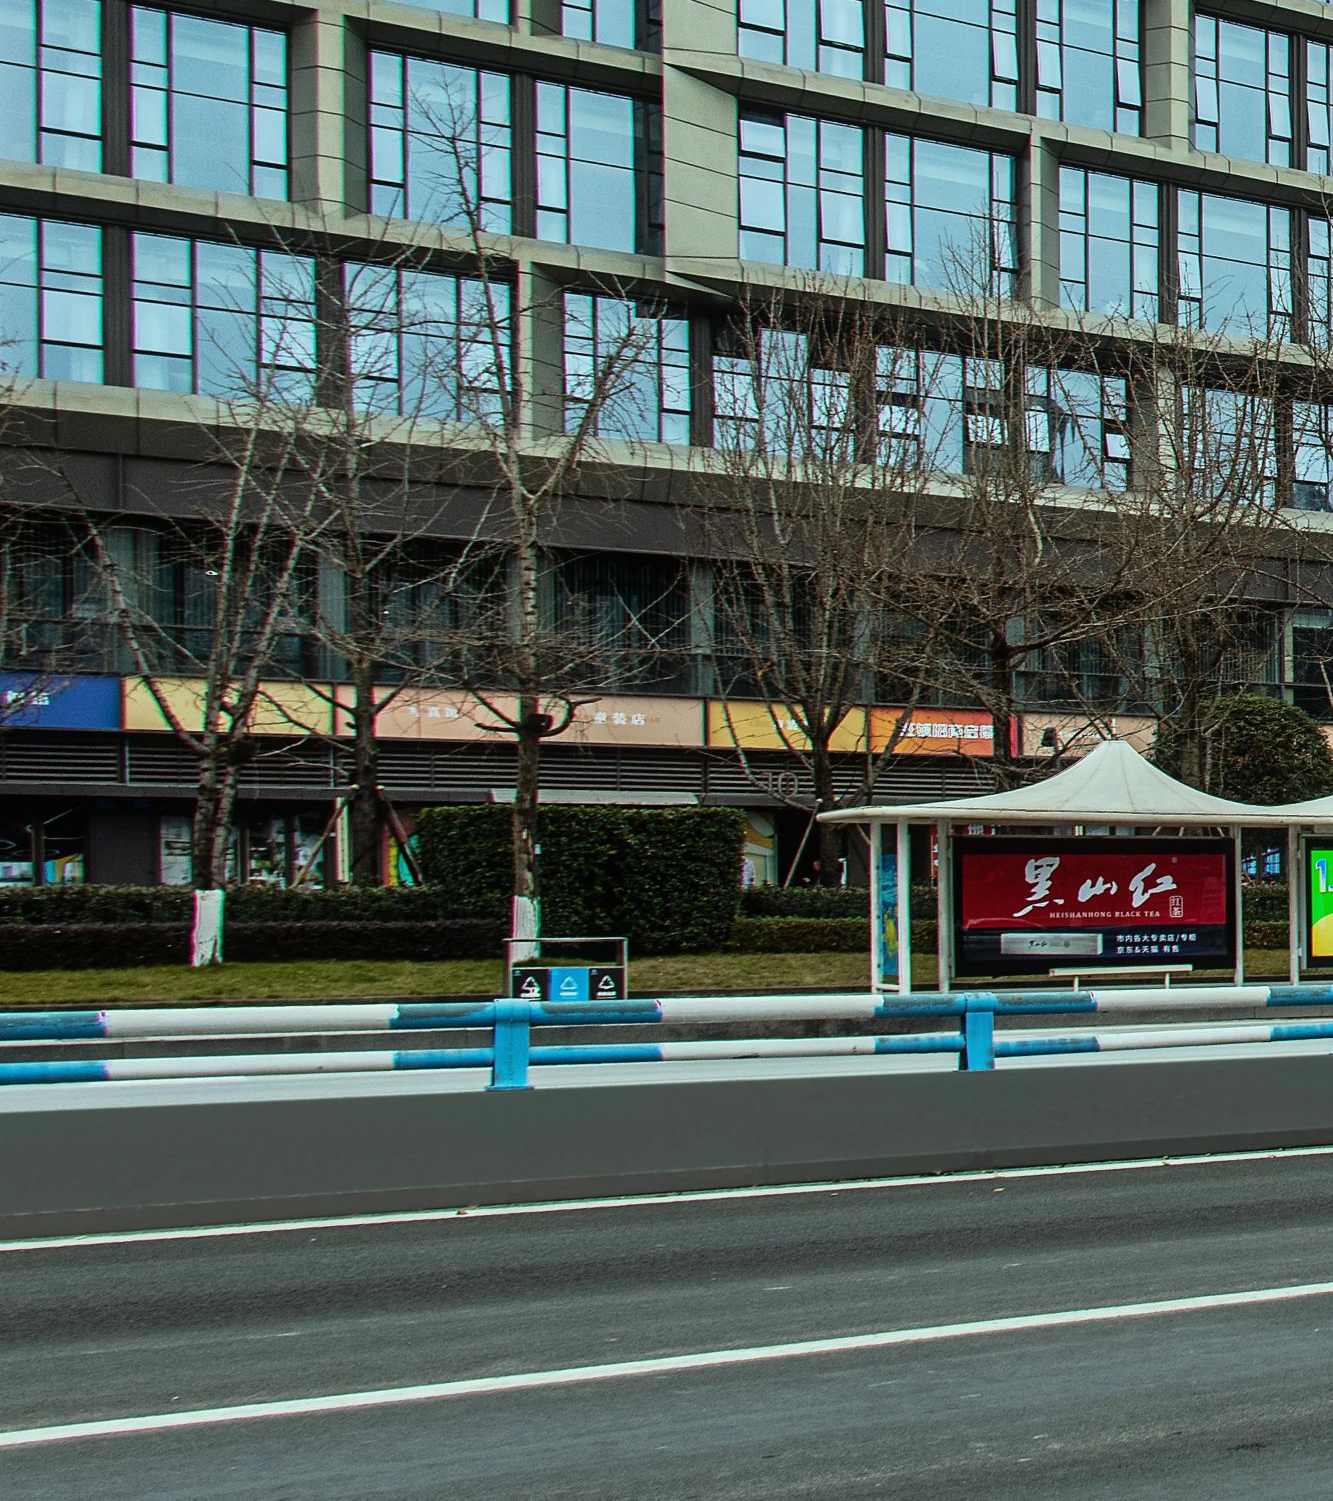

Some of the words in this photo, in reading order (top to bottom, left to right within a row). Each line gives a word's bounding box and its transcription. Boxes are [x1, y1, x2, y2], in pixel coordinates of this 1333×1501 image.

[1012, 856, 1178, 917] 黑山红
[1144, 910, 1161, 918] TEA
